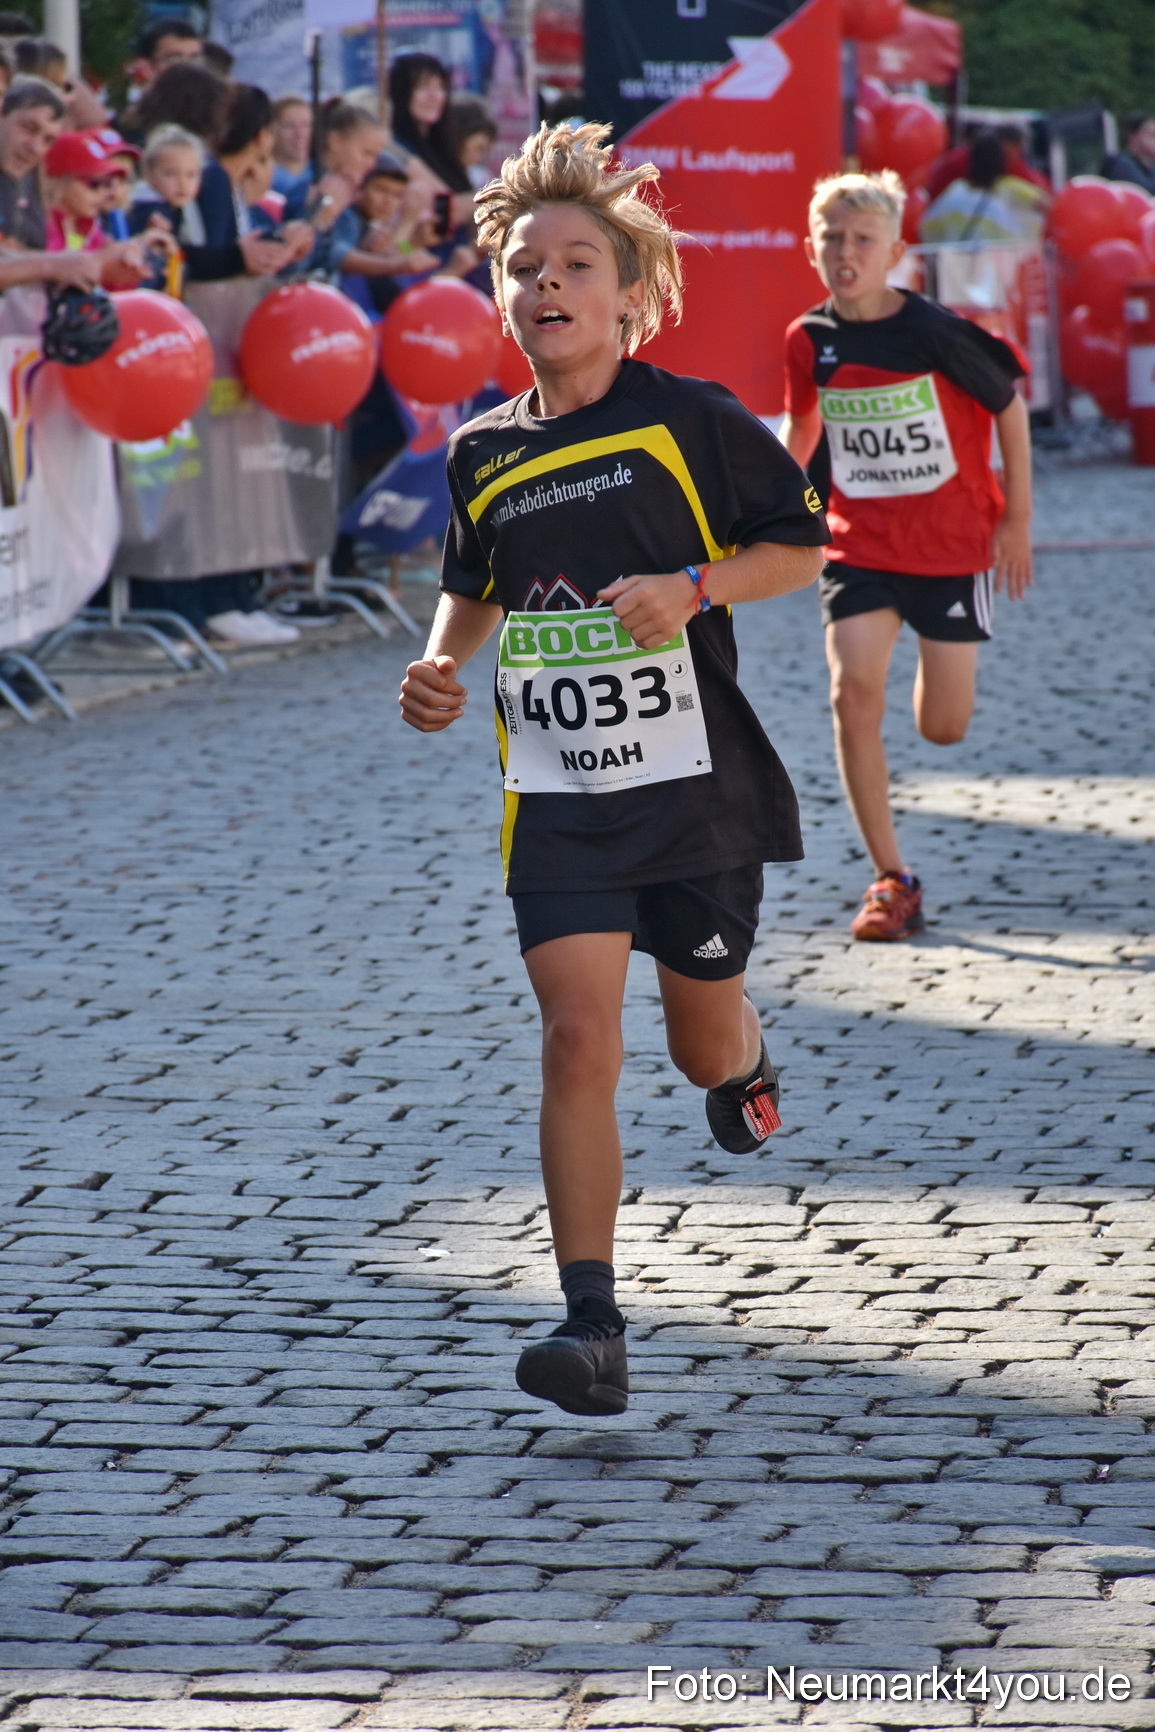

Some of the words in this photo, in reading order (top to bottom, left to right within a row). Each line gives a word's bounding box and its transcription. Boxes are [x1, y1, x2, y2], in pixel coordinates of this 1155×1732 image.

[681, 148, 796, 176] Laufsport
[826, 388, 922, 416] BOCK
[841, 421, 931, 459] 4045
[474, 445, 526, 485] saller
[846, 463, 940, 482] JONATHAN
[522, 666, 671, 731] 4033
[560, 741, 644, 771] NOAH
[693, 948, 729, 958] adidas
